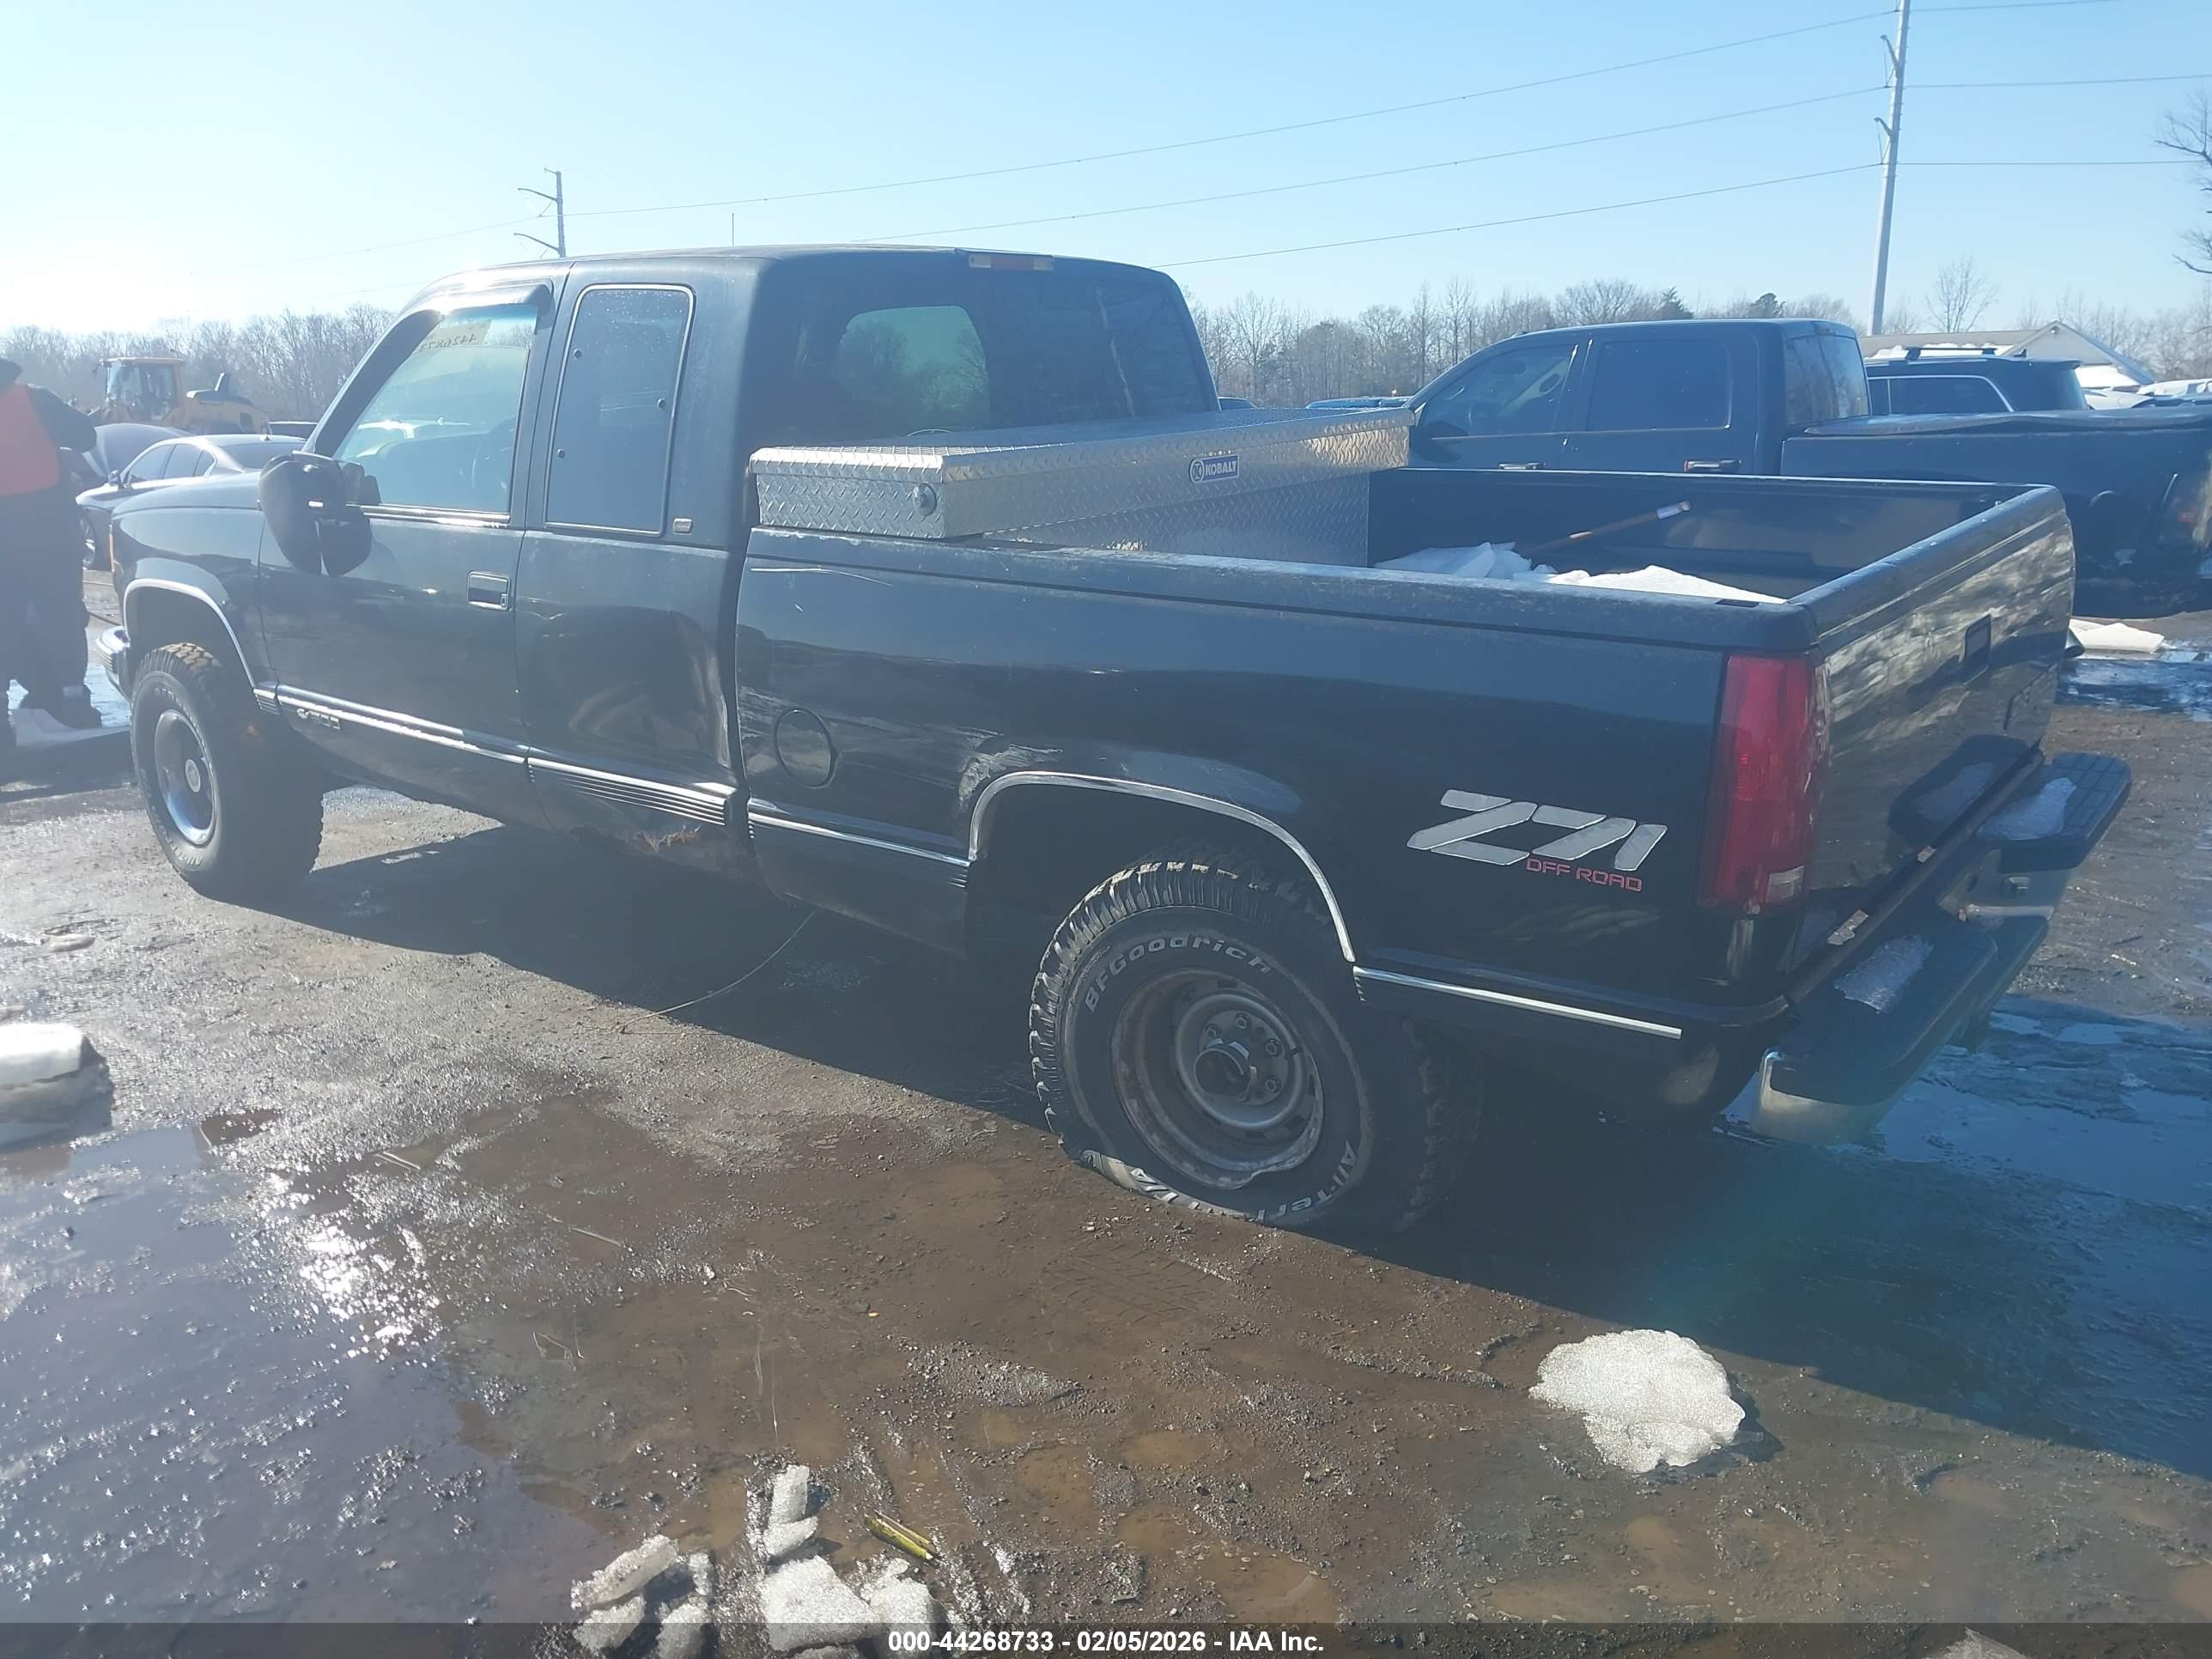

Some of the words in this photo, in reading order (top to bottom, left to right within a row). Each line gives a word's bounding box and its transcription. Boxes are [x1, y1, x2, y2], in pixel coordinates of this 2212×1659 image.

[1205, 461, 1237, 477] KOBALT
[1407, 789, 1668, 871] Z71
[1526, 859, 1571, 876] OFF
[1576, 867, 1642, 892] ROAD
